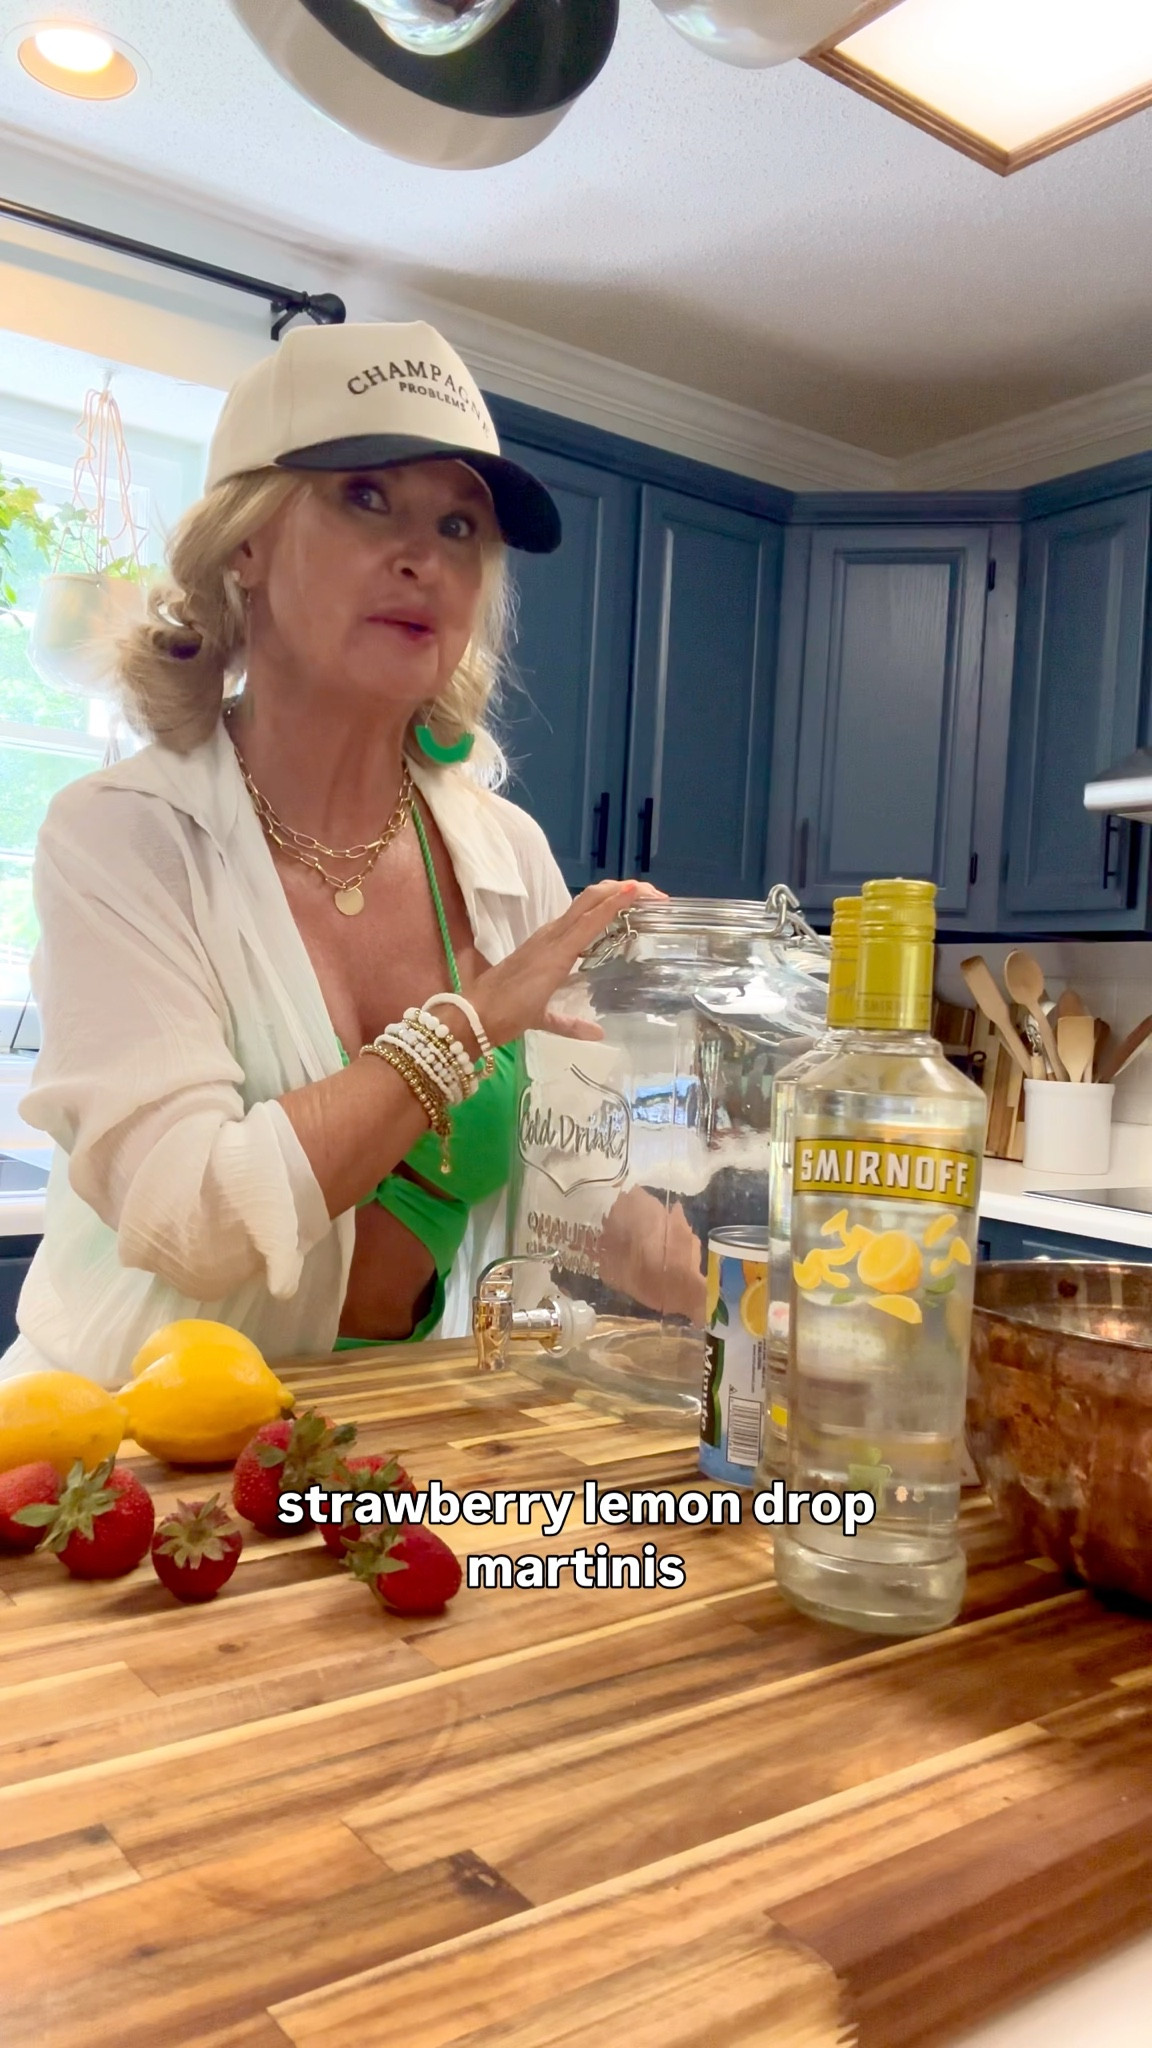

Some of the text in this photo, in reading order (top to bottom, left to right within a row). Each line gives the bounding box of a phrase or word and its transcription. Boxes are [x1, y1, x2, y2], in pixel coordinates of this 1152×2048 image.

[398, 381, 467, 413] PROBLEMS
[520, 1107, 556, 1151] Cold
[801, 1148, 969, 1196] SMIRNOFF
[702, 1344, 714, 1432] Minute
